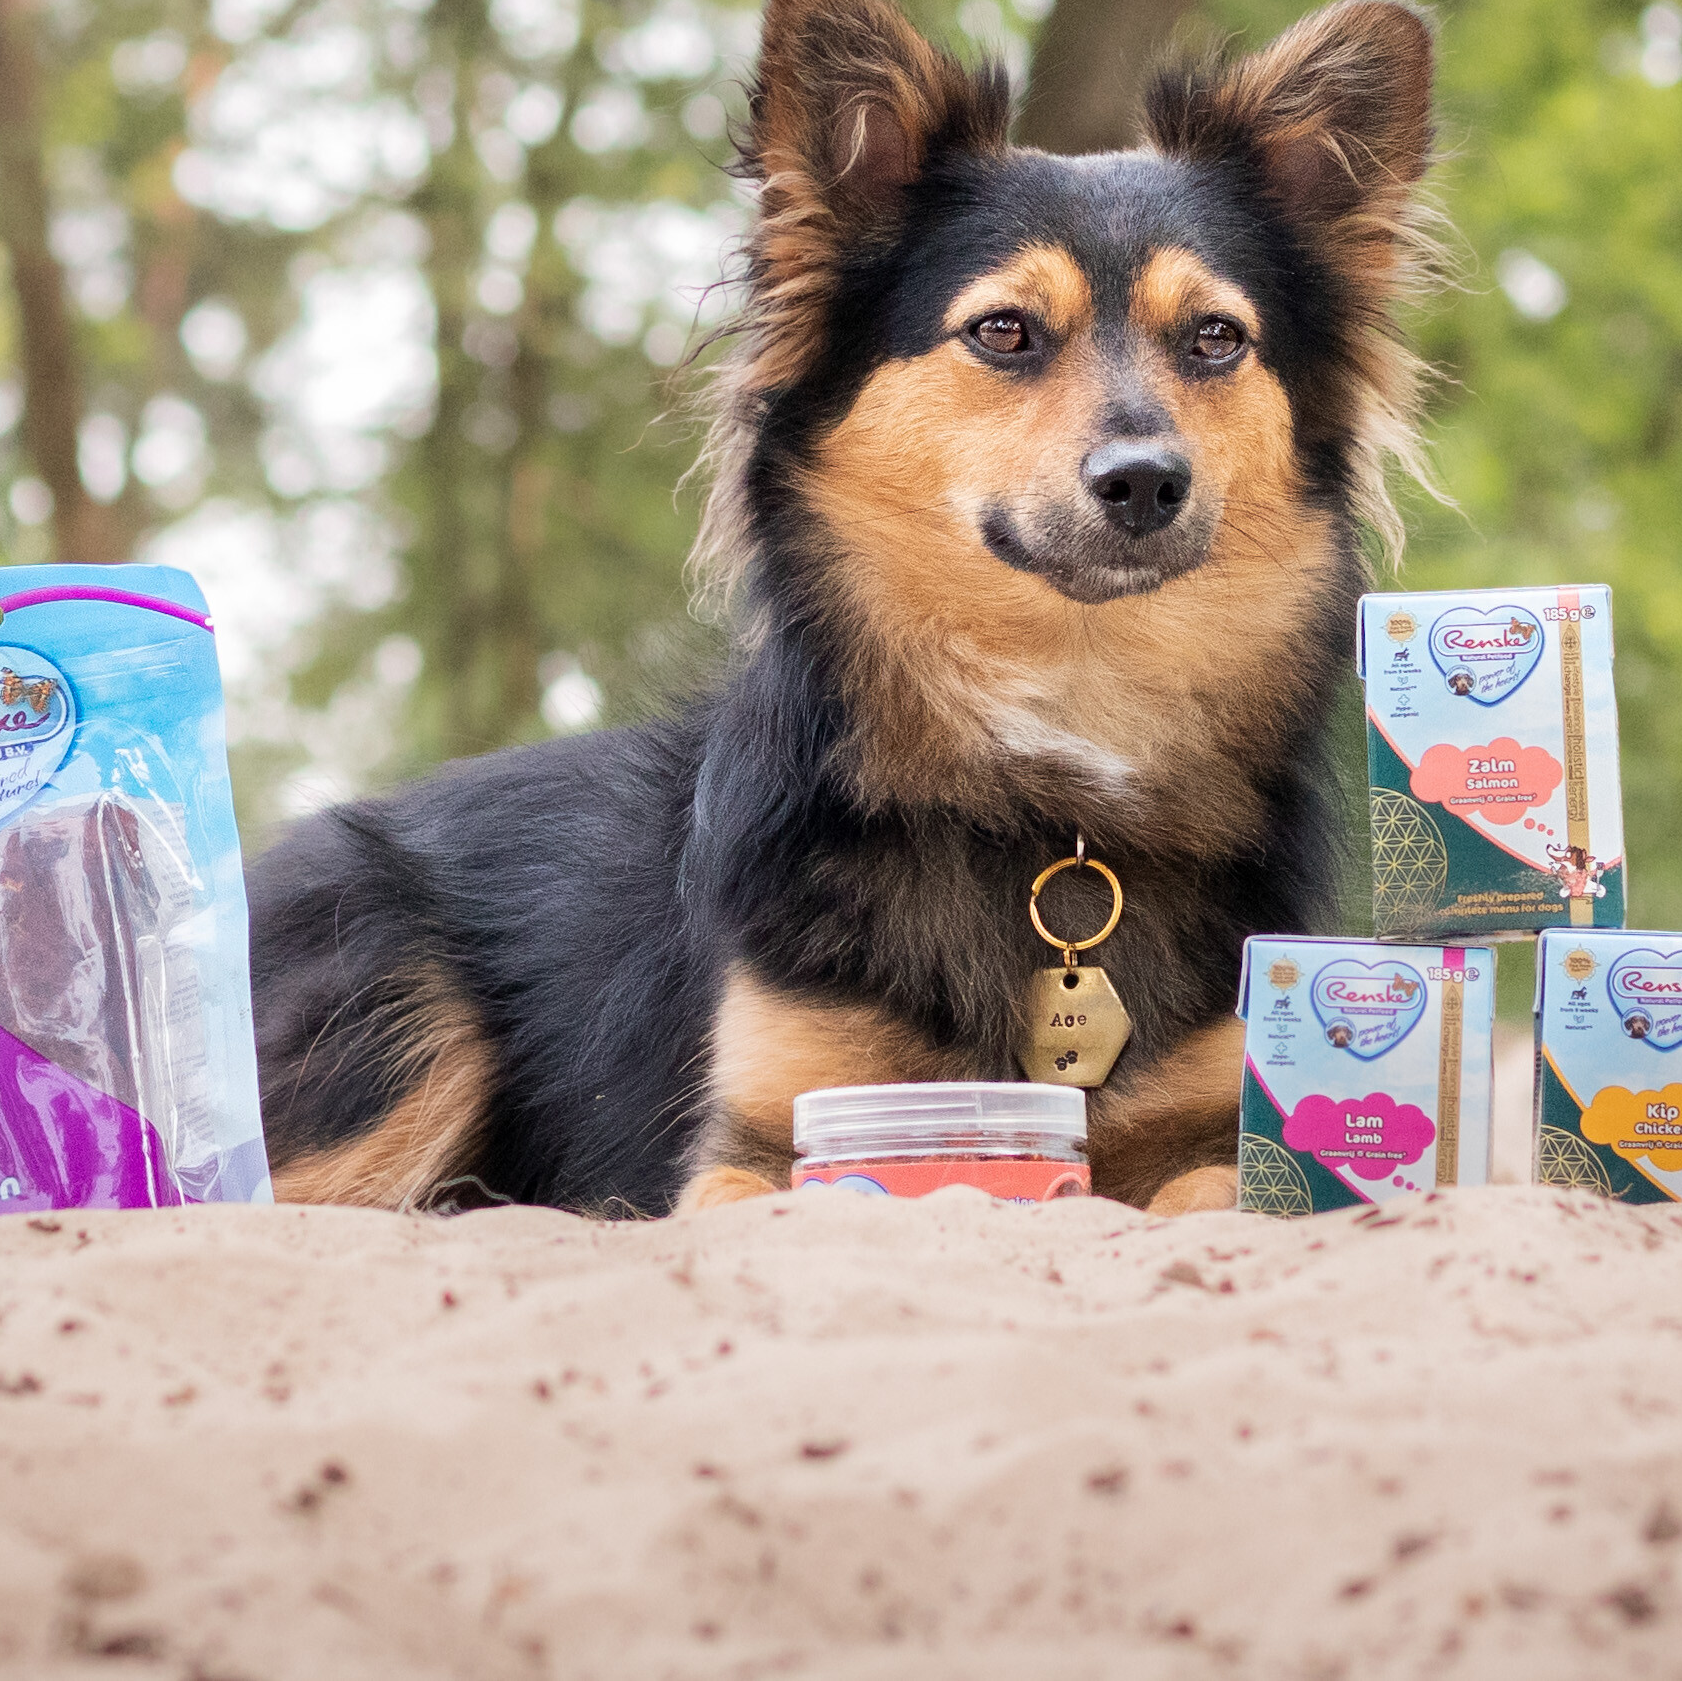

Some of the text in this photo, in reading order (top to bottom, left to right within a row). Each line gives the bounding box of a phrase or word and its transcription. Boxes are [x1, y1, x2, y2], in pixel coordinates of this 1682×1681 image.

[1443, 607, 1581, 649] Renske 185 g
[5, 744, 29, 758] B.V.
[1573, 738, 1585, 776] holistic
[1468, 757, 1516, 774] Zalm
[1466, 777, 1519, 790] Salmon
[1497, 891, 1544, 902] prepared
[1489, 904, 1519, 914] menu
[1521, 903, 1536, 912] for
[1538, 902, 1564, 913] dogs
[1327, 967, 1463, 1003] Renske 185 g
[1646, 1101, 1680, 1122] Kip
[1345, 1113, 1384, 1129] Lam
[1345, 1132, 1383, 1144] Lamb
